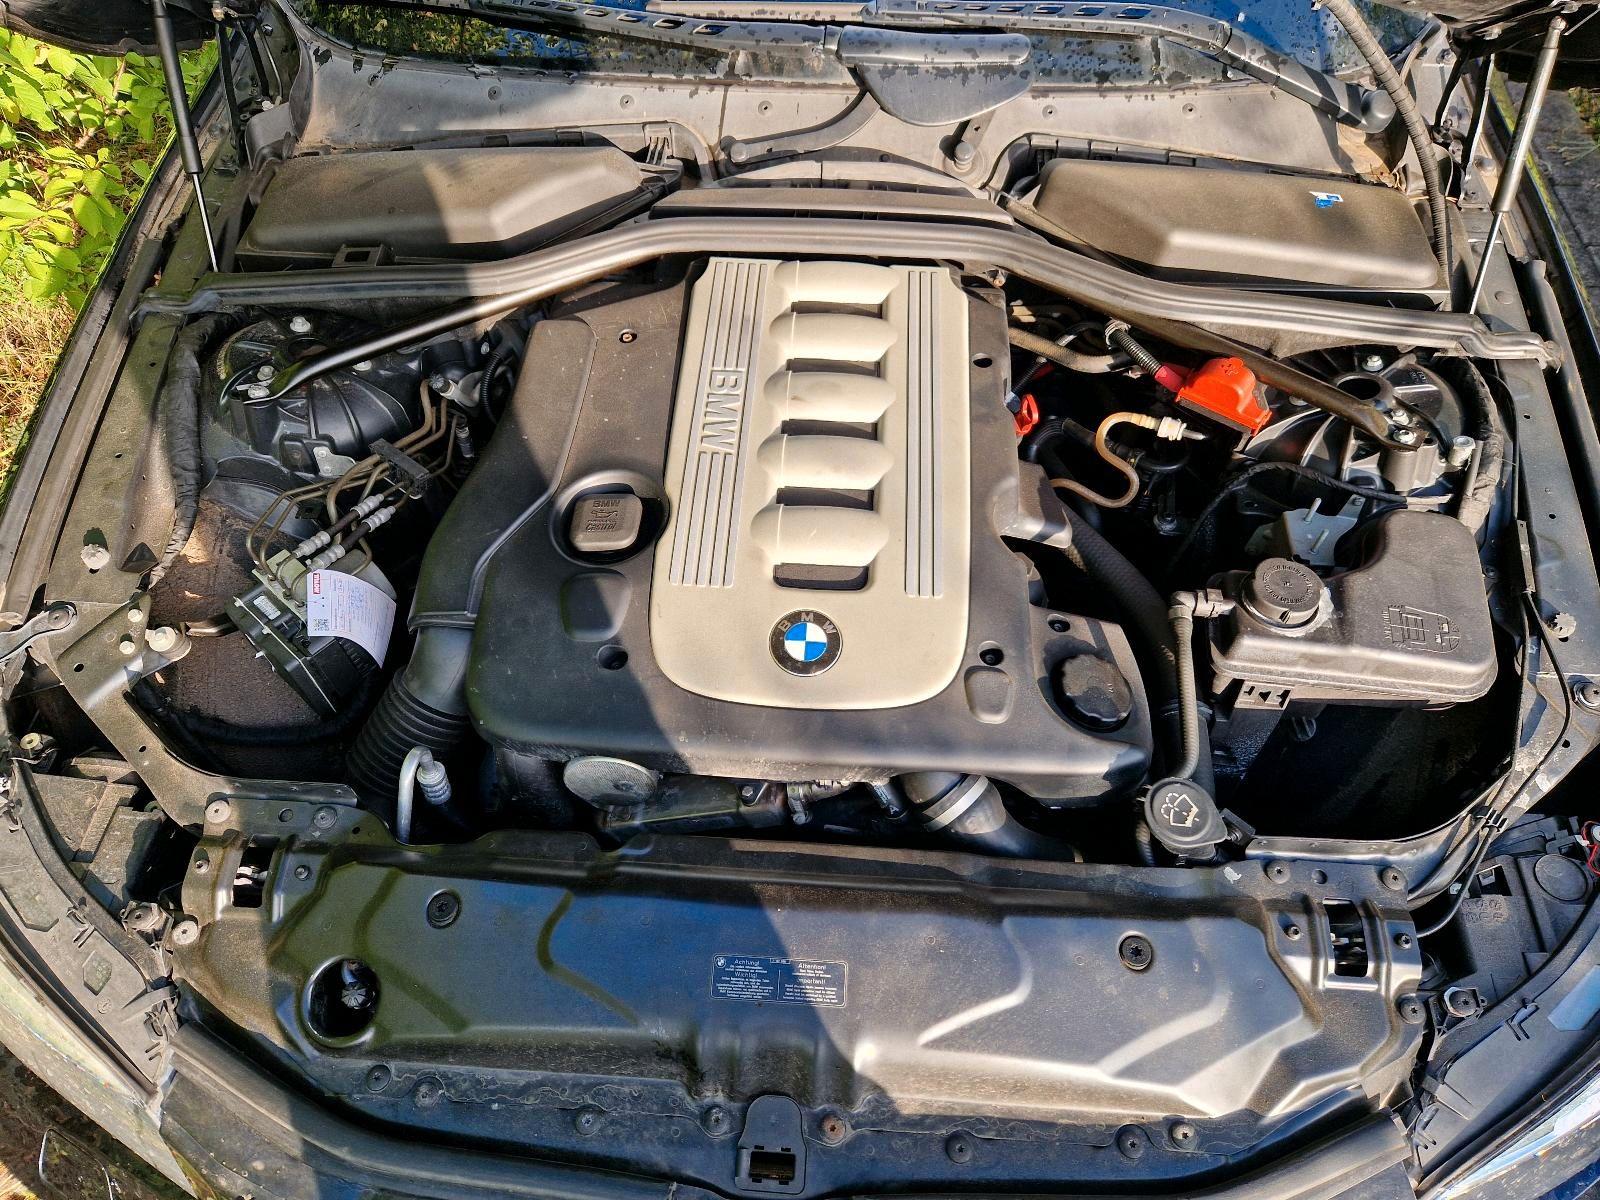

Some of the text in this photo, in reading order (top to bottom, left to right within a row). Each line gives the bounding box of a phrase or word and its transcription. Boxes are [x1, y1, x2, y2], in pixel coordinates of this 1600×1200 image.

[701, 370, 745, 451] BMW
[592, 500, 620, 508] BMW
[778, 612, 837, 634] BMW
[734, 959, 760, 967] Achtung!
[734, 971, 758, 979] Wichtig!
